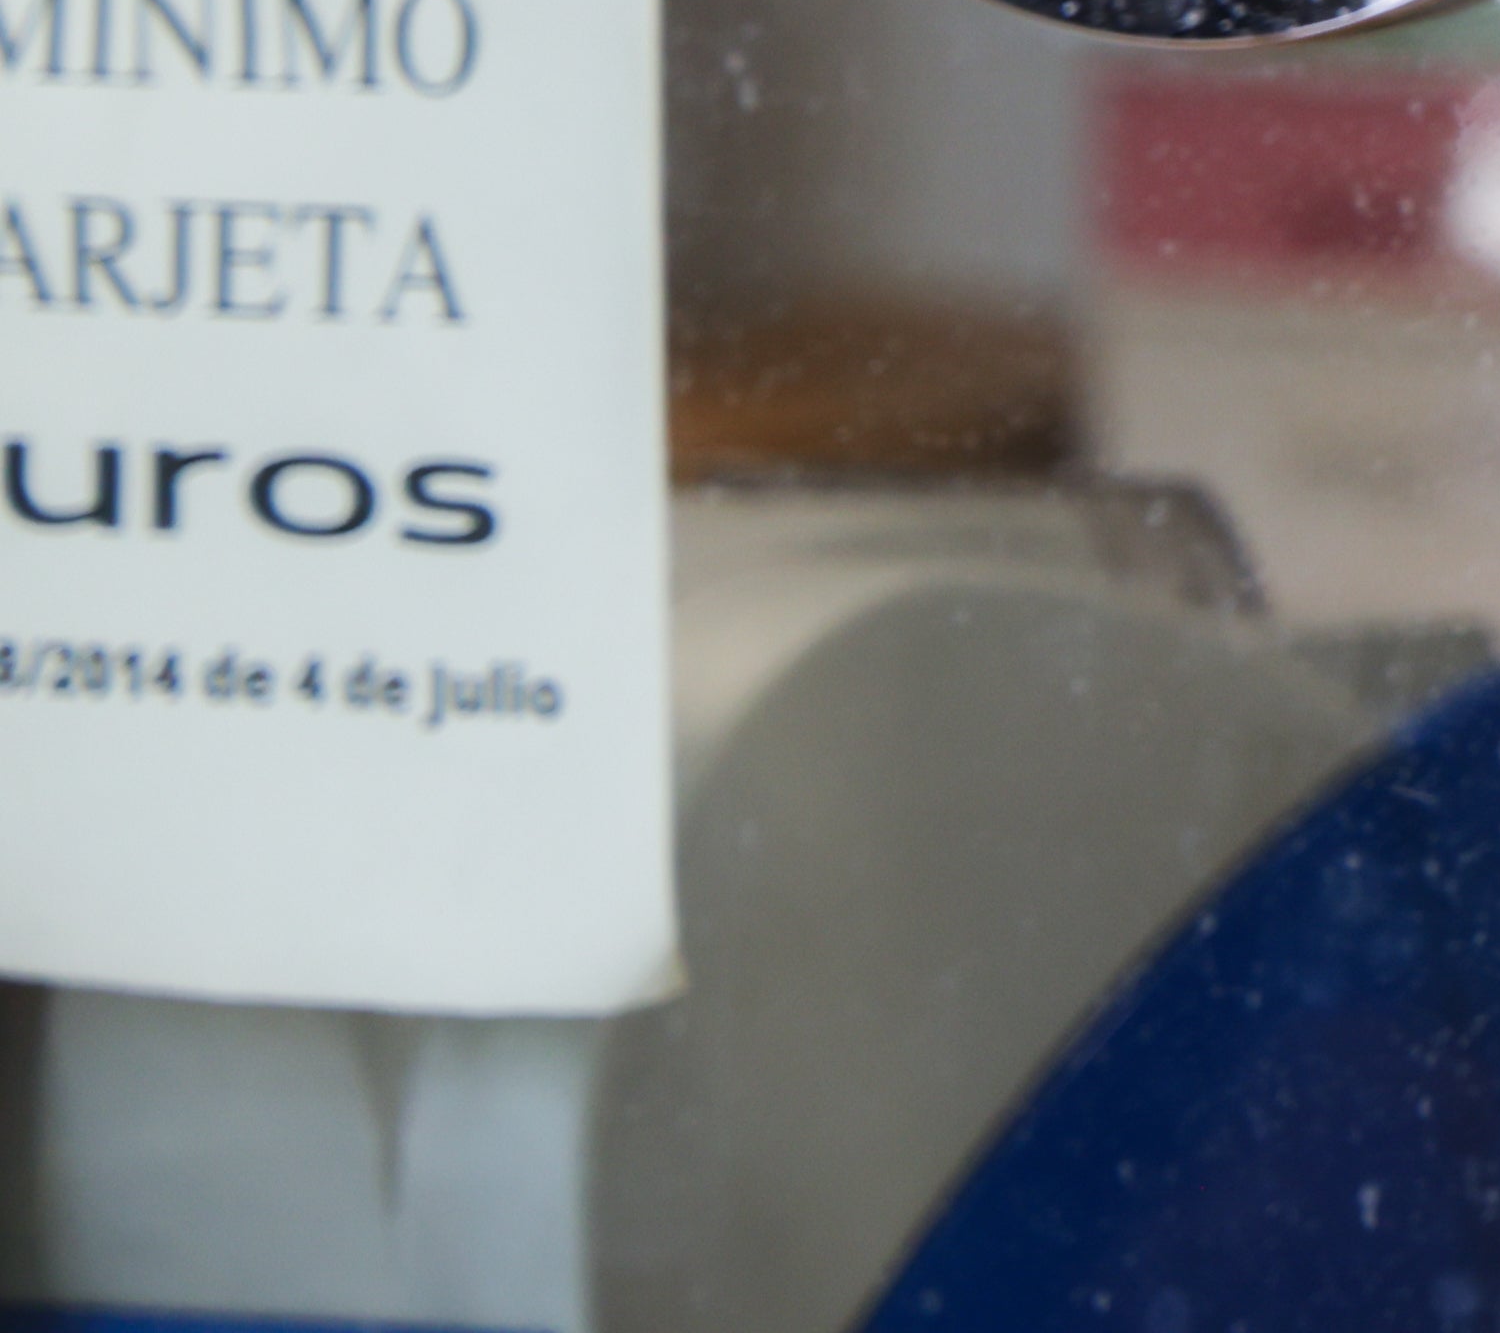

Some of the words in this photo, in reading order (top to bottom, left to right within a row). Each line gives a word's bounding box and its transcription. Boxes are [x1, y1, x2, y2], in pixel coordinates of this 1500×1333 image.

[1, 433, 503, 549] uros
[201, 646, 276, 706] de
[293, 651, 327, 706] 4
[343, 649, 413, 712] de
